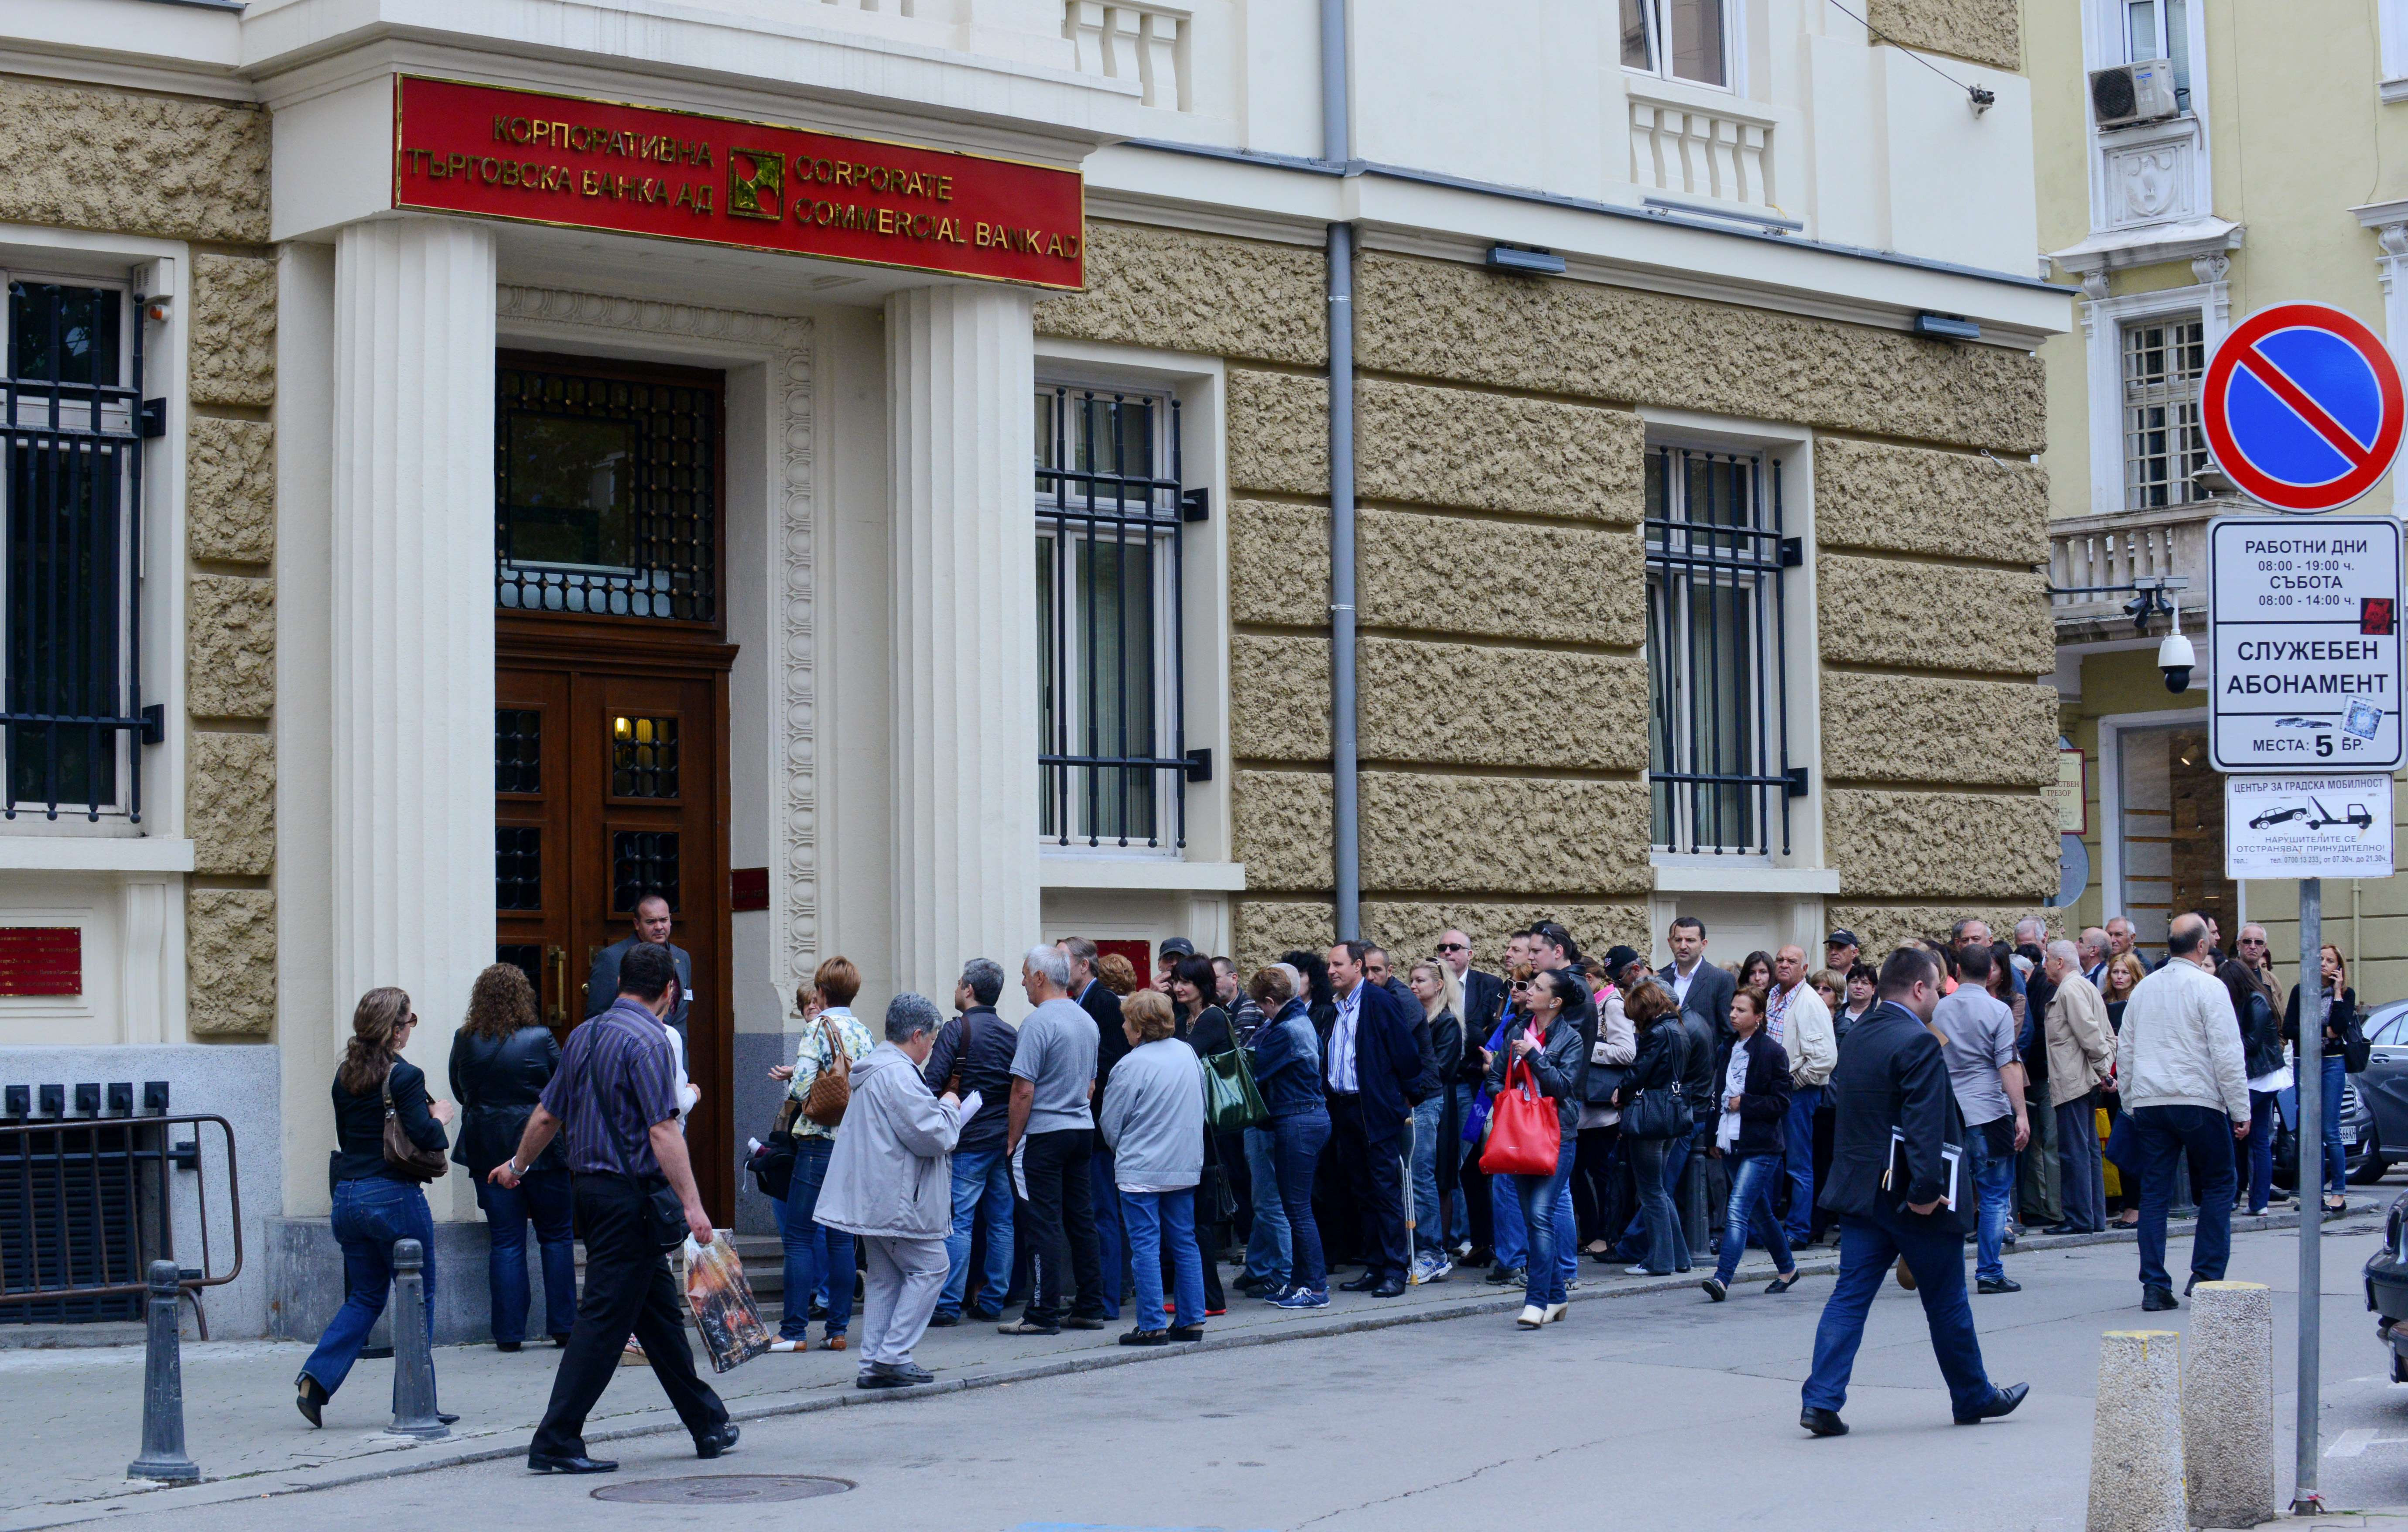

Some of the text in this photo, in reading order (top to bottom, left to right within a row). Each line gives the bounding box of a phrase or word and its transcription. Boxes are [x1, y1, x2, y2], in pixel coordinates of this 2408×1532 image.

[493, 114, 714, 168] КОРПОРАТИВНА
[407, 147, 714, 215] ТЪРГОВСКА БАНКА АД
[794, 155, 953, 201] CORPORATE
[794, 198, 1079, 258] COMMERCIAL BANK AD
[2245, 540, 2367, 555] РАБОТНИ ДНИ
[2258, 561, 2292, 571] 08:00
[2305, 560, 2339, 571] 19:00
[2270, 575, 2343, 589] СЪБОТА
[2259, 595, 2293, 605] 08:00
[2306, 595, 2340, 605] 14:00
[2238, 641, 2378, 660] СЛУЖЕБЕН
[2227, 674, 2388, 694] АБОНАМЕНТ
[2253, 735, 2364, 757] МЕСТА: 5 БР.
[2234, 779, 2383, 793] ЦЕНТЪР ЗА ГРАДСКА МОБИЛНОСТ
